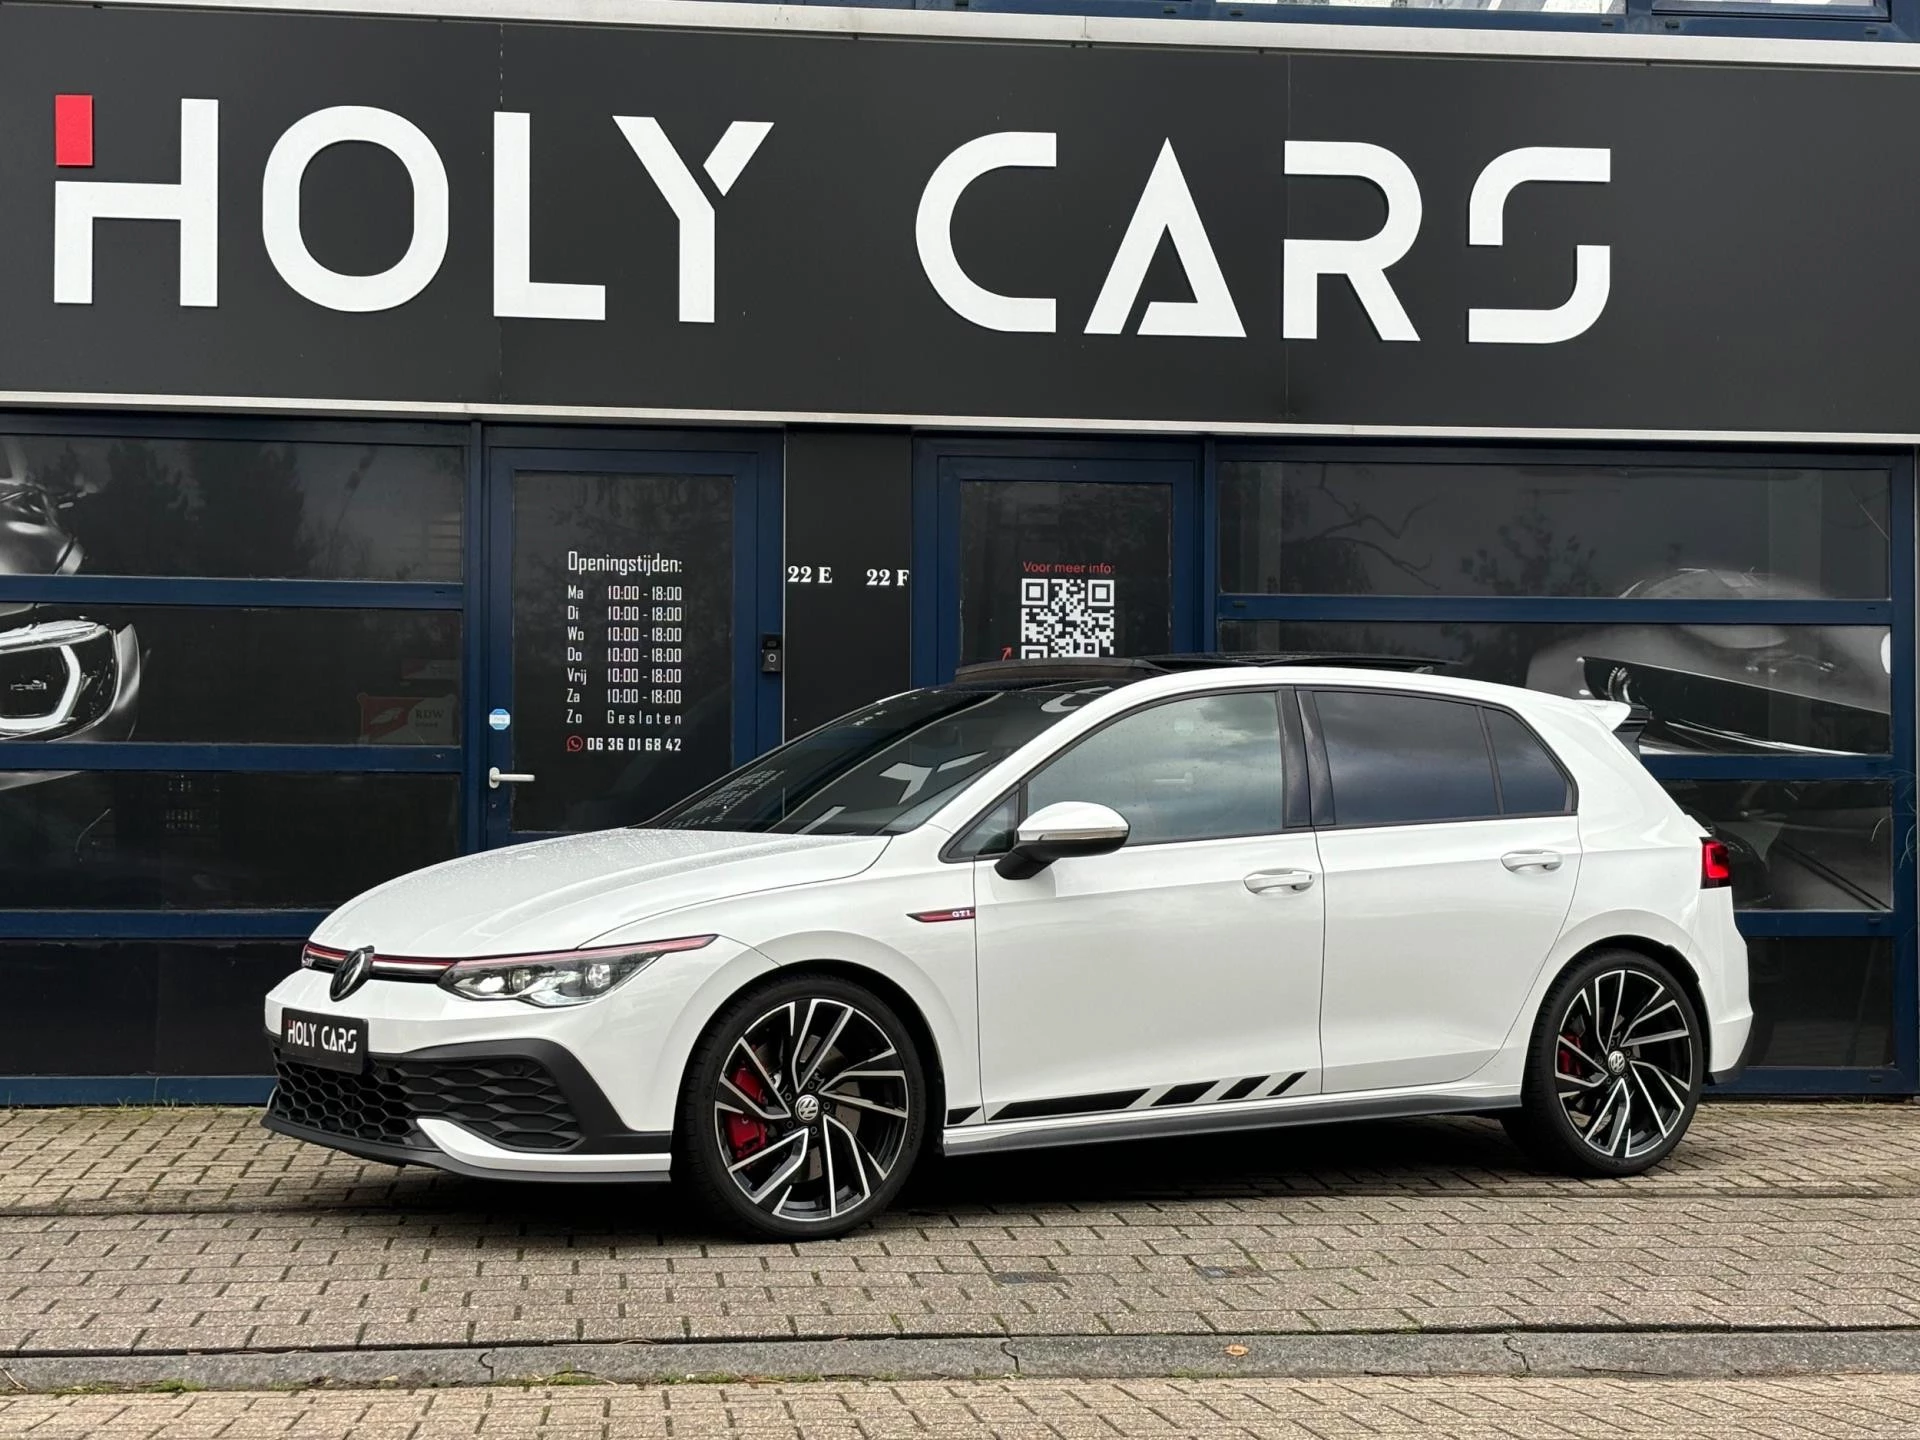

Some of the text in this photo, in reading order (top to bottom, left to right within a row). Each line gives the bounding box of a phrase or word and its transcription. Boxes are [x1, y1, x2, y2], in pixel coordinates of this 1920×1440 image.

[54, 95, 1610, 343] HOLY CARS
[568, 551, 682, 576] Openingstijden:
[1023, 562, 1051, 573] Voor
[1055, 564, 1085, 574] meer
[788, 566, 832, 583] 22 E
[867, 569, 909, 586] 22 F
[568, 585, 583, 599] Ma
[608, 586, 639, 600] 10:00
[652, 586, 682, 601] 18:00
[568, 605, 579, 620] Di
[608, 606, 639, 621] 10:00
[652, 607, 681, 621] 18:00
[568, 626, 584, 640] Wo
[608, 627, 639, 641] 10:00
[652, 627, 681, 642] 18:00
[568, 647, 582, 661] Do
[608, 648, 638, 662] 10:00
[652, 648, 681, 662] 18:00
[567, 668, 586, 684] Vrij
[608, 668, 638, 682] 10:00
[652, 669, 681, 683] 18:00
[567, 688, 580, 702] Za
[608, 689, 638, 703] 10:00
[652, 689, 681, 704] 18:00
[567, 709, 582, 723] Zo
[587, 738, 681, 751] 06 36 01 68 42
[288, 1019, 357, 1053] HOLY CARS
